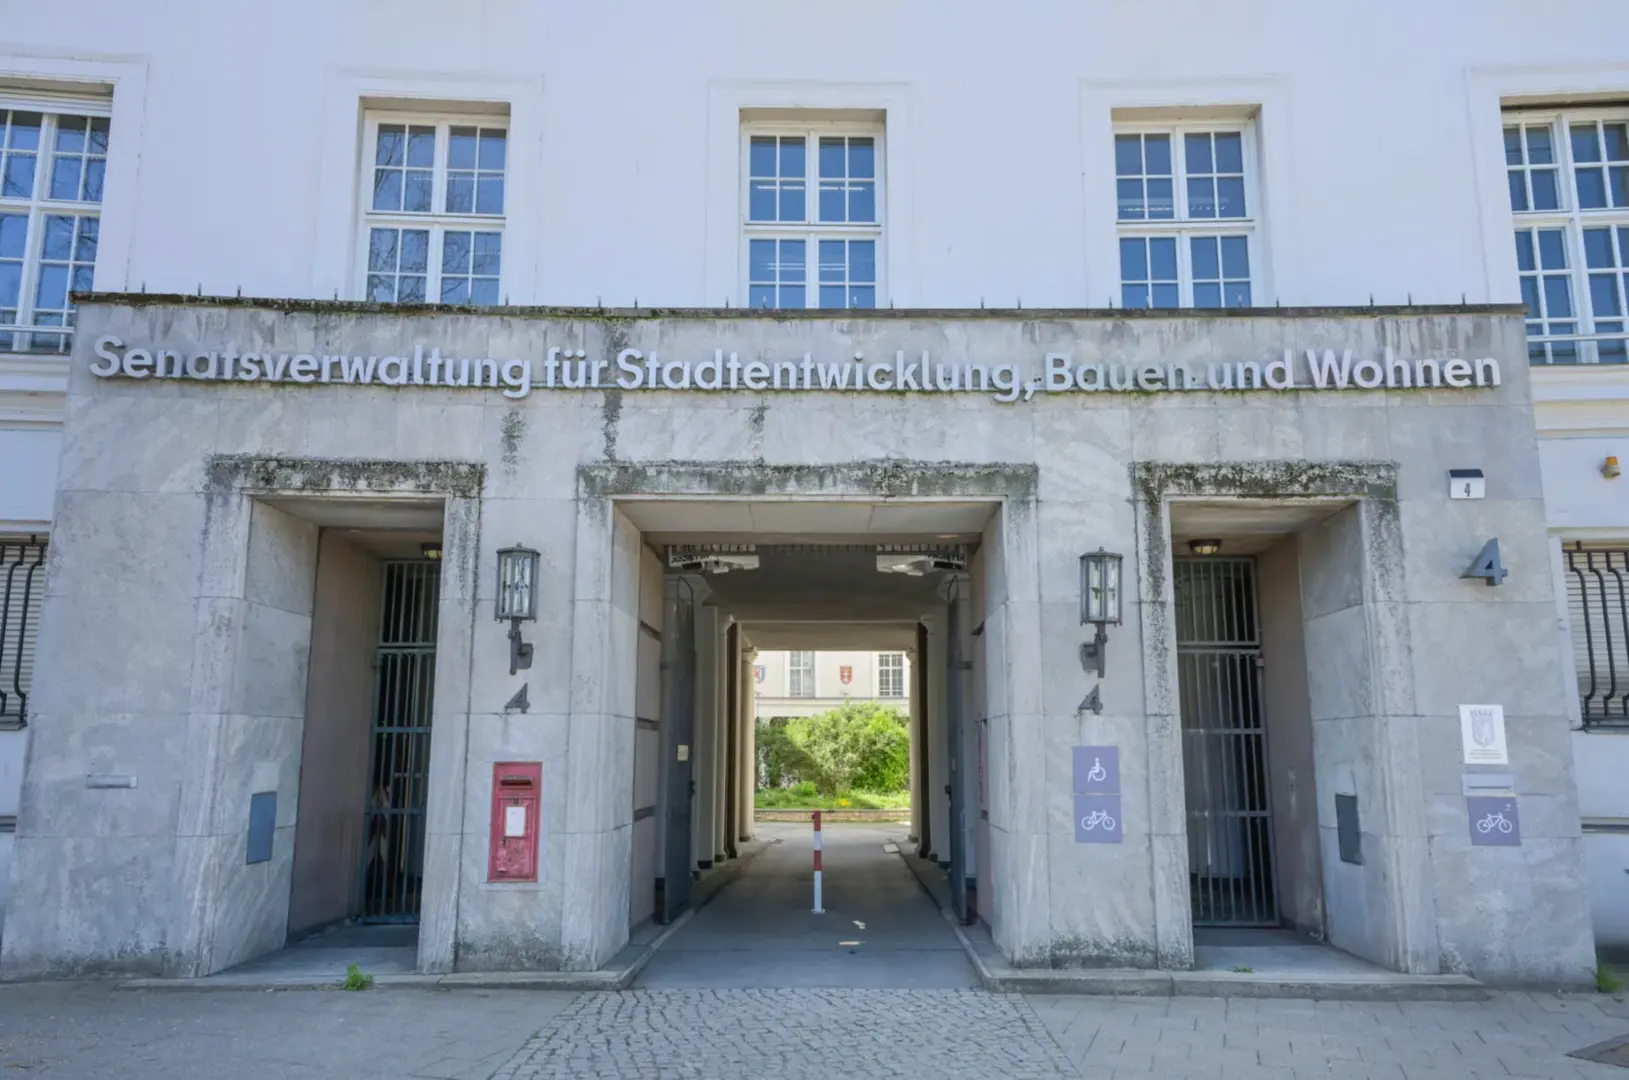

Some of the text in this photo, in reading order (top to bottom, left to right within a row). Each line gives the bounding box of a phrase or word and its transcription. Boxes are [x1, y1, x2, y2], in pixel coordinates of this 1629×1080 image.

[89, 335, 1501, 402] Senatsverwaltung für Stadtentwicklung, Bauen und Wohnen
[1464, 483, 1471, 497] 4
[1462, 537, 1508, 586] 4
[504, 682, 530, 714] 4
[1079, 684, 1103, 715] 4
